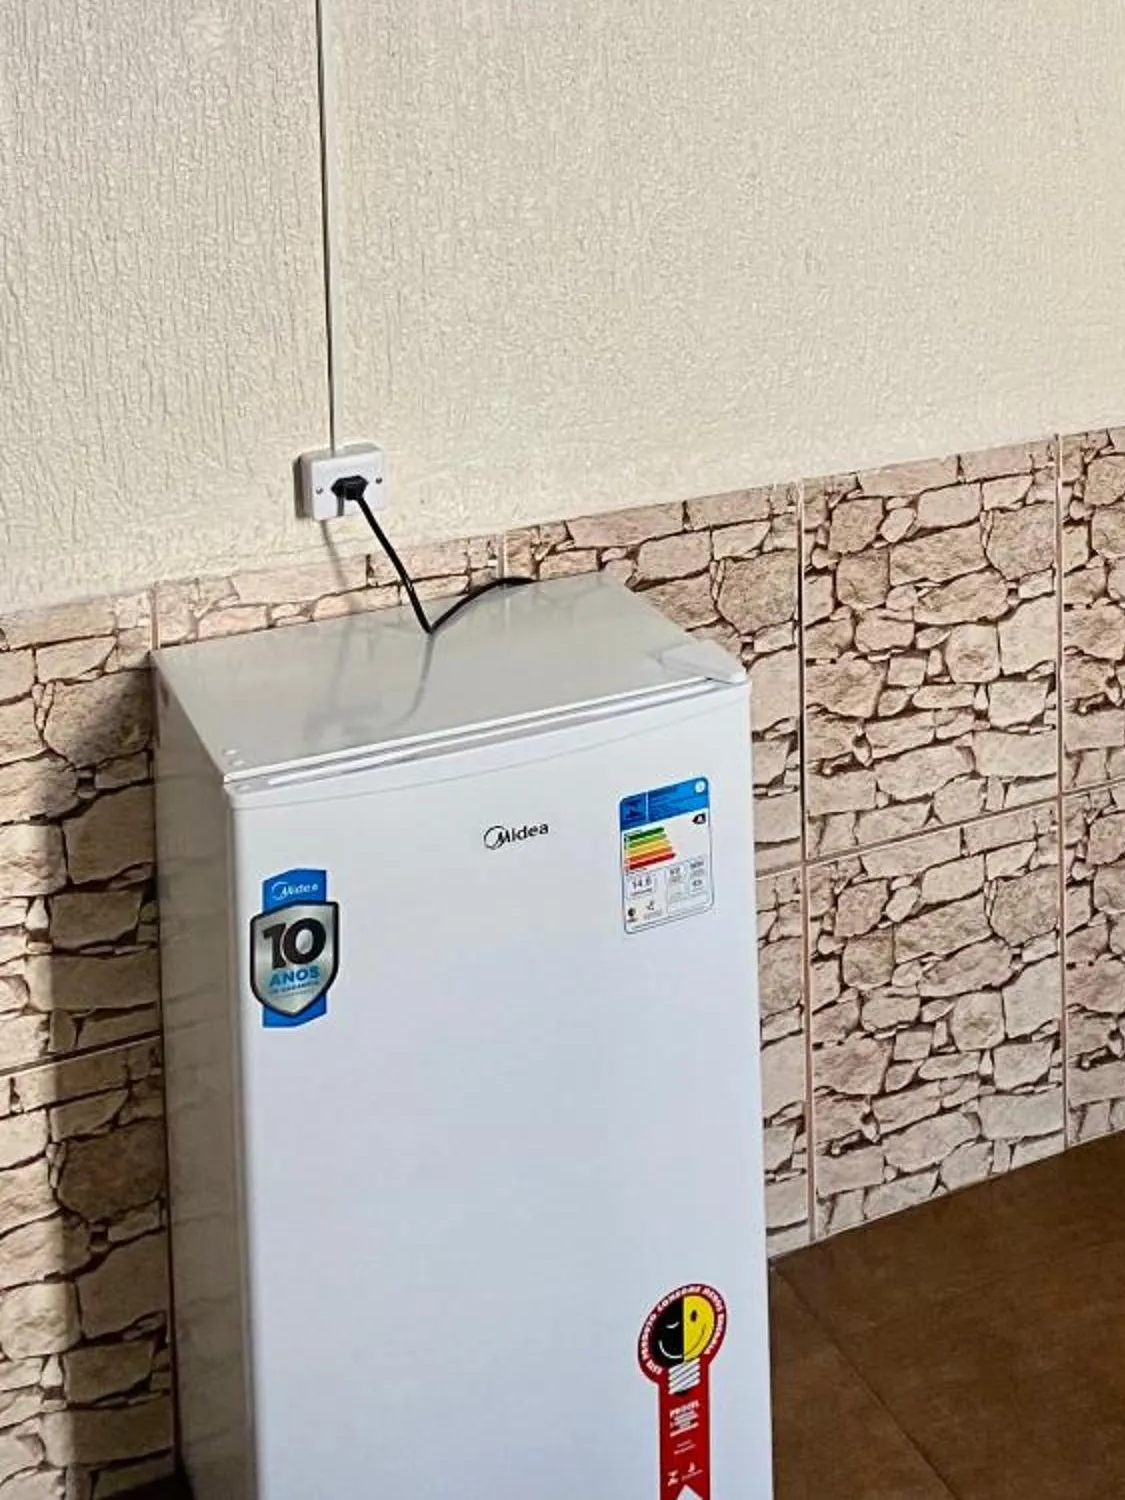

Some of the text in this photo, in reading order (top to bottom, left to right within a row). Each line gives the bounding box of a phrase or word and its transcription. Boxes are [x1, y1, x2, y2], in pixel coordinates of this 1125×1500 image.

[483, 823, 549, 850] Midea
[271, 880, 319, 901] Midea
[262, 917, 327, 970] 10
[269, 964, 321, 988] ANOS
